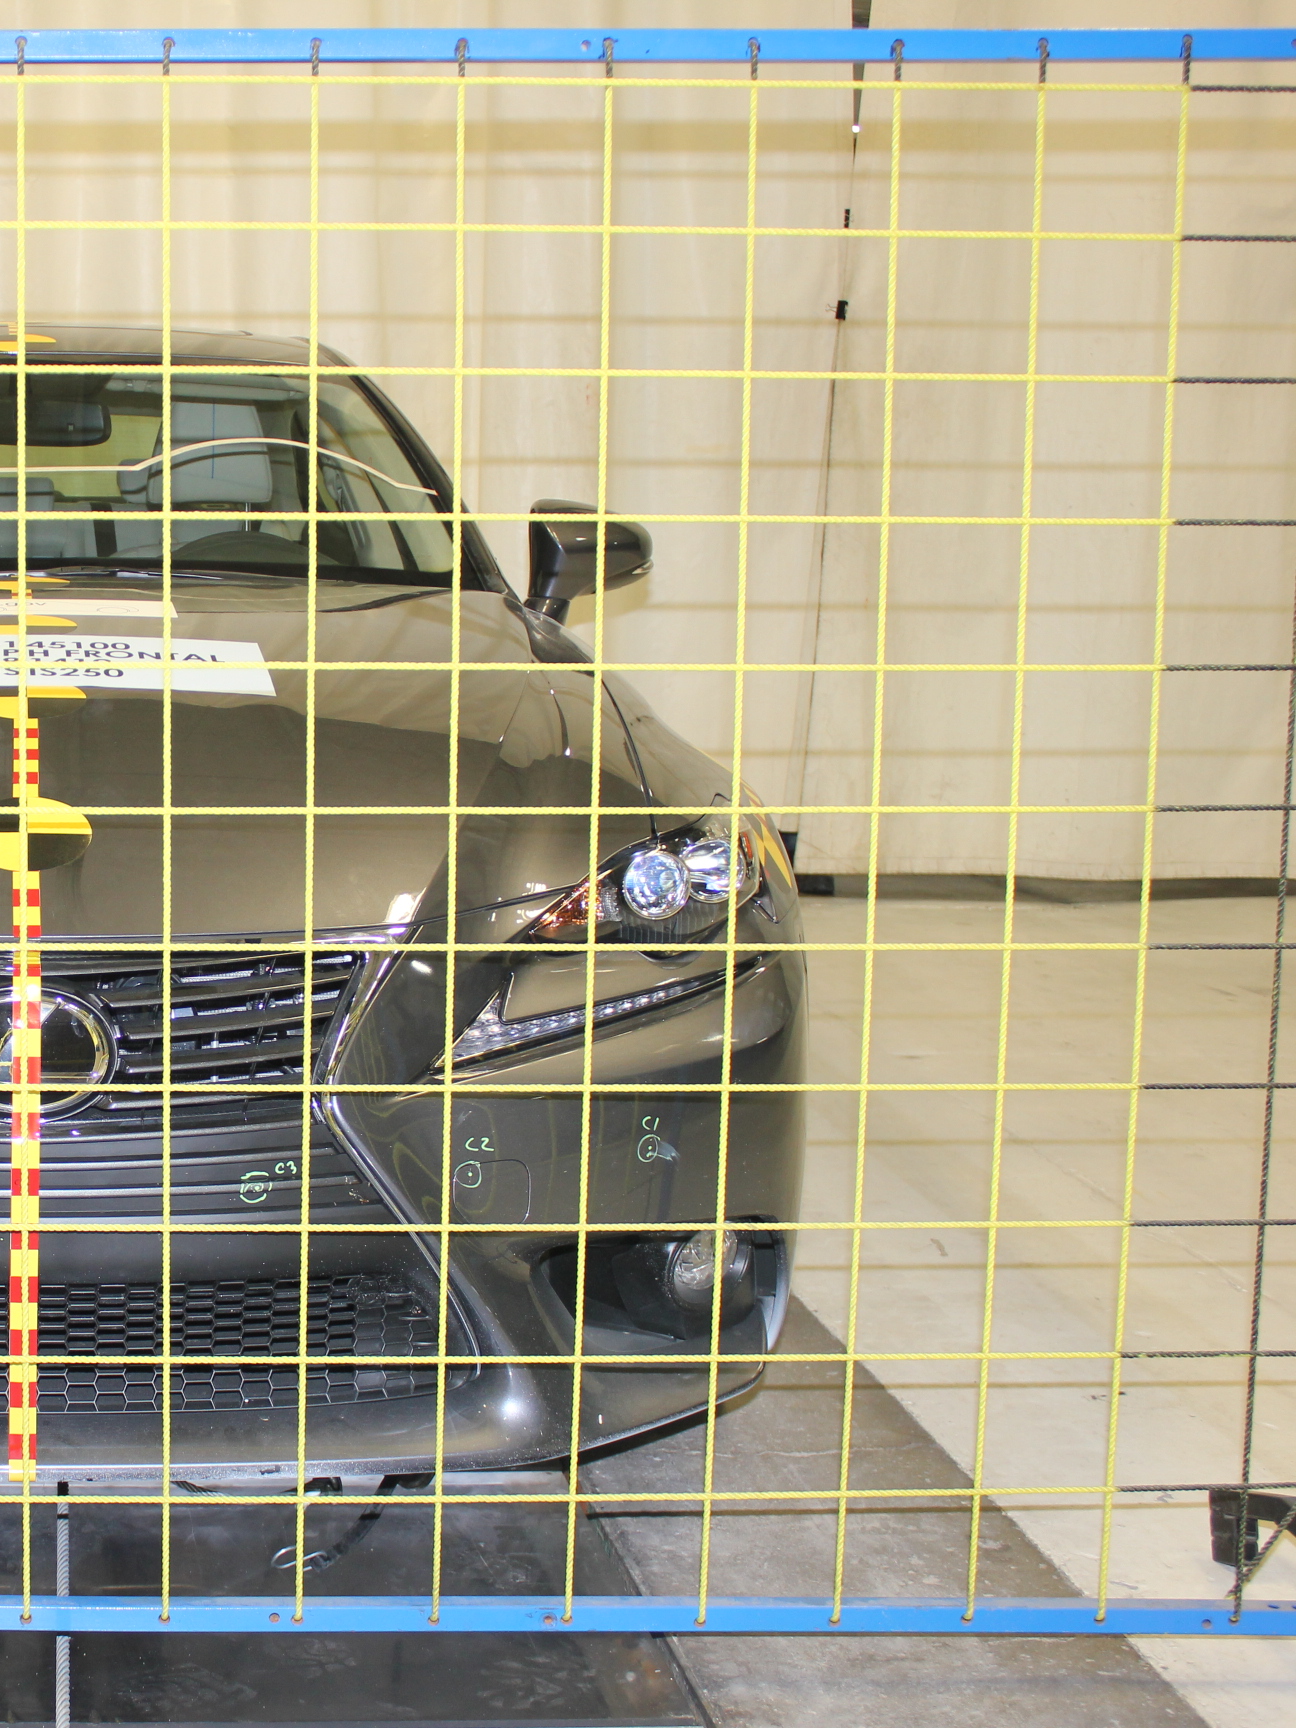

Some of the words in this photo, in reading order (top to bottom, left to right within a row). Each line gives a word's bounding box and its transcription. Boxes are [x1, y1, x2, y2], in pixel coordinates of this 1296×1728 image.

[65, 649, 226, 663] FRONTAL
[29, 667, 124, 678] IS250
[642, 1115, 660, 1131] C1
[464, 1136, 495, 1152] C2
[274, 1160, 297, 1174] C3
